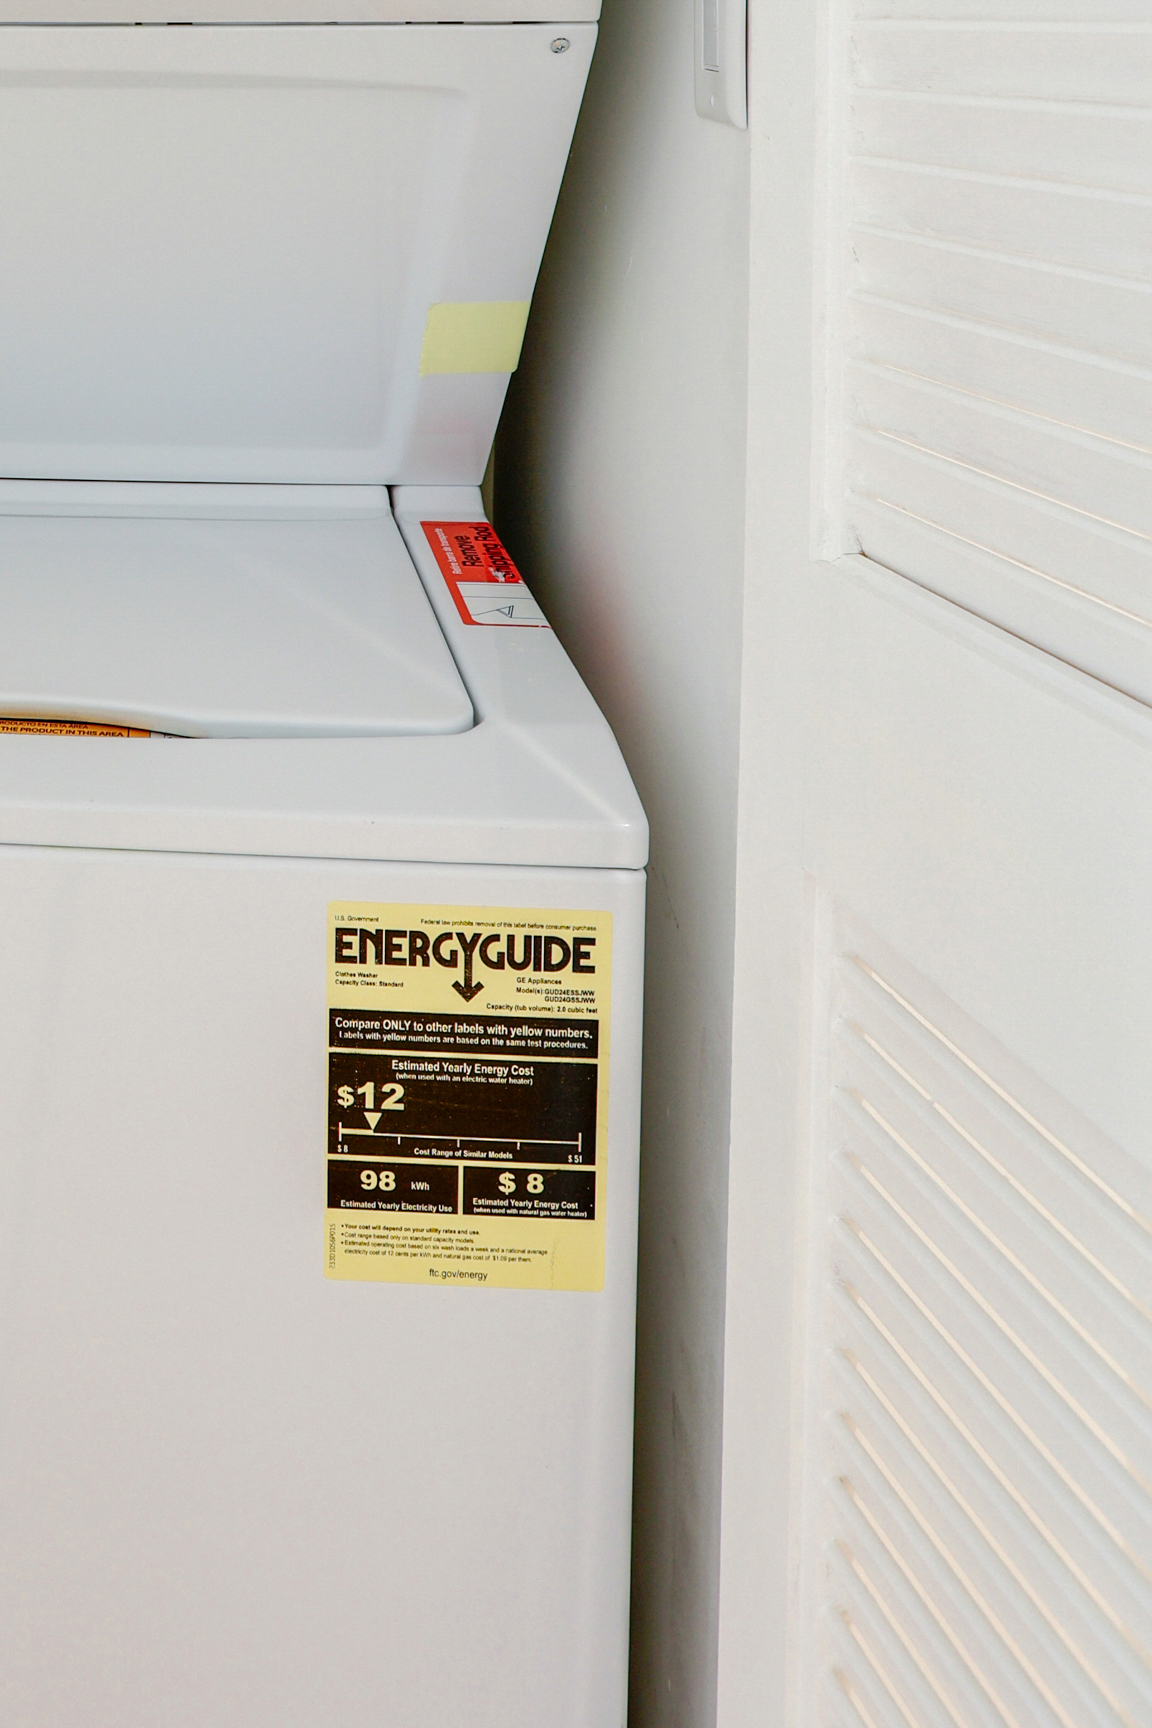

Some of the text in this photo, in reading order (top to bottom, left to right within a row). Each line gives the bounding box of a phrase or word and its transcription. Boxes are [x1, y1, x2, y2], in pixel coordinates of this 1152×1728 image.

[469, 526, 497, 542] Rod
[454, 535, 484, 567] Remove
[20, 727, 63, 735] PRODUCT
[335, 927, 595, 974] ENERGYGUIDE
[335, 1017, 592, 1039] Compare ONLY to other labels with yellow numbers.
[392, 1059, 534, 1077] Estimated Yearly Energy Cost
[337, 1081, 405, 1111] $12
[360, 1169, 429, 1191] 98 kWh
[498, 1171, 544, 1196] $ 8
[341, 1199, 452, 1213] Estimated Yearly Electricity Use
[473, 1197, 578, 1210] Estimated Yearly Energy Cost
[430, 1268, 488, 1281] ftc.gov/energy
